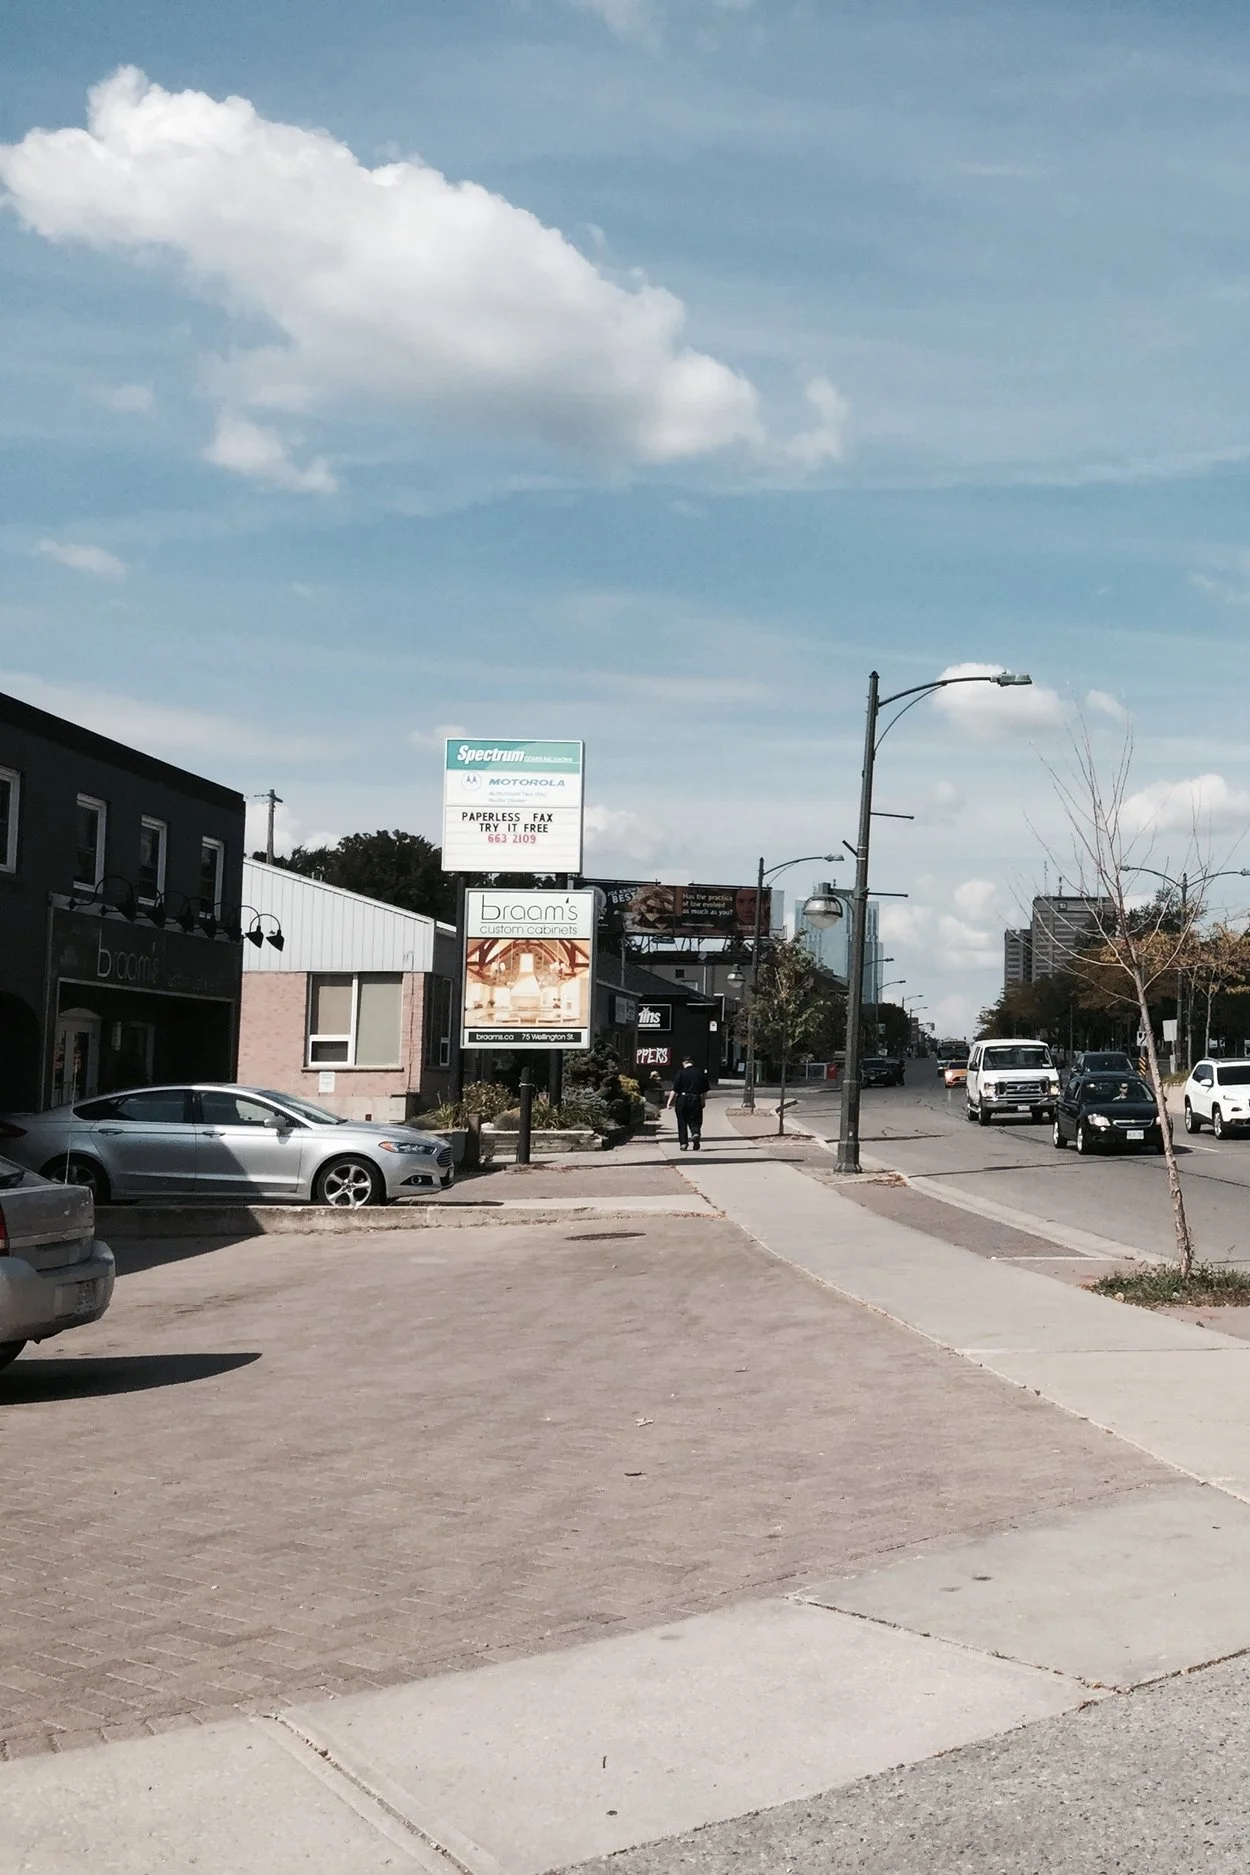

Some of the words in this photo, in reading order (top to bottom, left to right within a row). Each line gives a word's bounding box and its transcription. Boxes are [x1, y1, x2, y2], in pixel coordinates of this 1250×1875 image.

[457, 745, 525, 764] Spectrum
[488, 778, 566, 787] MOTOROLA
[461, 812, 520, 822] PAPERLESS
[533, 813, 554, 823] FAX
[479, 824, 499, 833] TRY
[507, 824, 517, 833] IT
[524, 824, 549, 833] FREE
[487, 834, 507, 843] 663
[513, 834, 537, 844] 2109
[708, 894, 733, 902] practice
[481, 894, 578, 921] braam's
[480, 925, 524, 935] custom
[527, 924, 578, 935] cabinets
[521, 1033, 531, 1041] 75
[531, 1033, 566, 1042] Wellington
